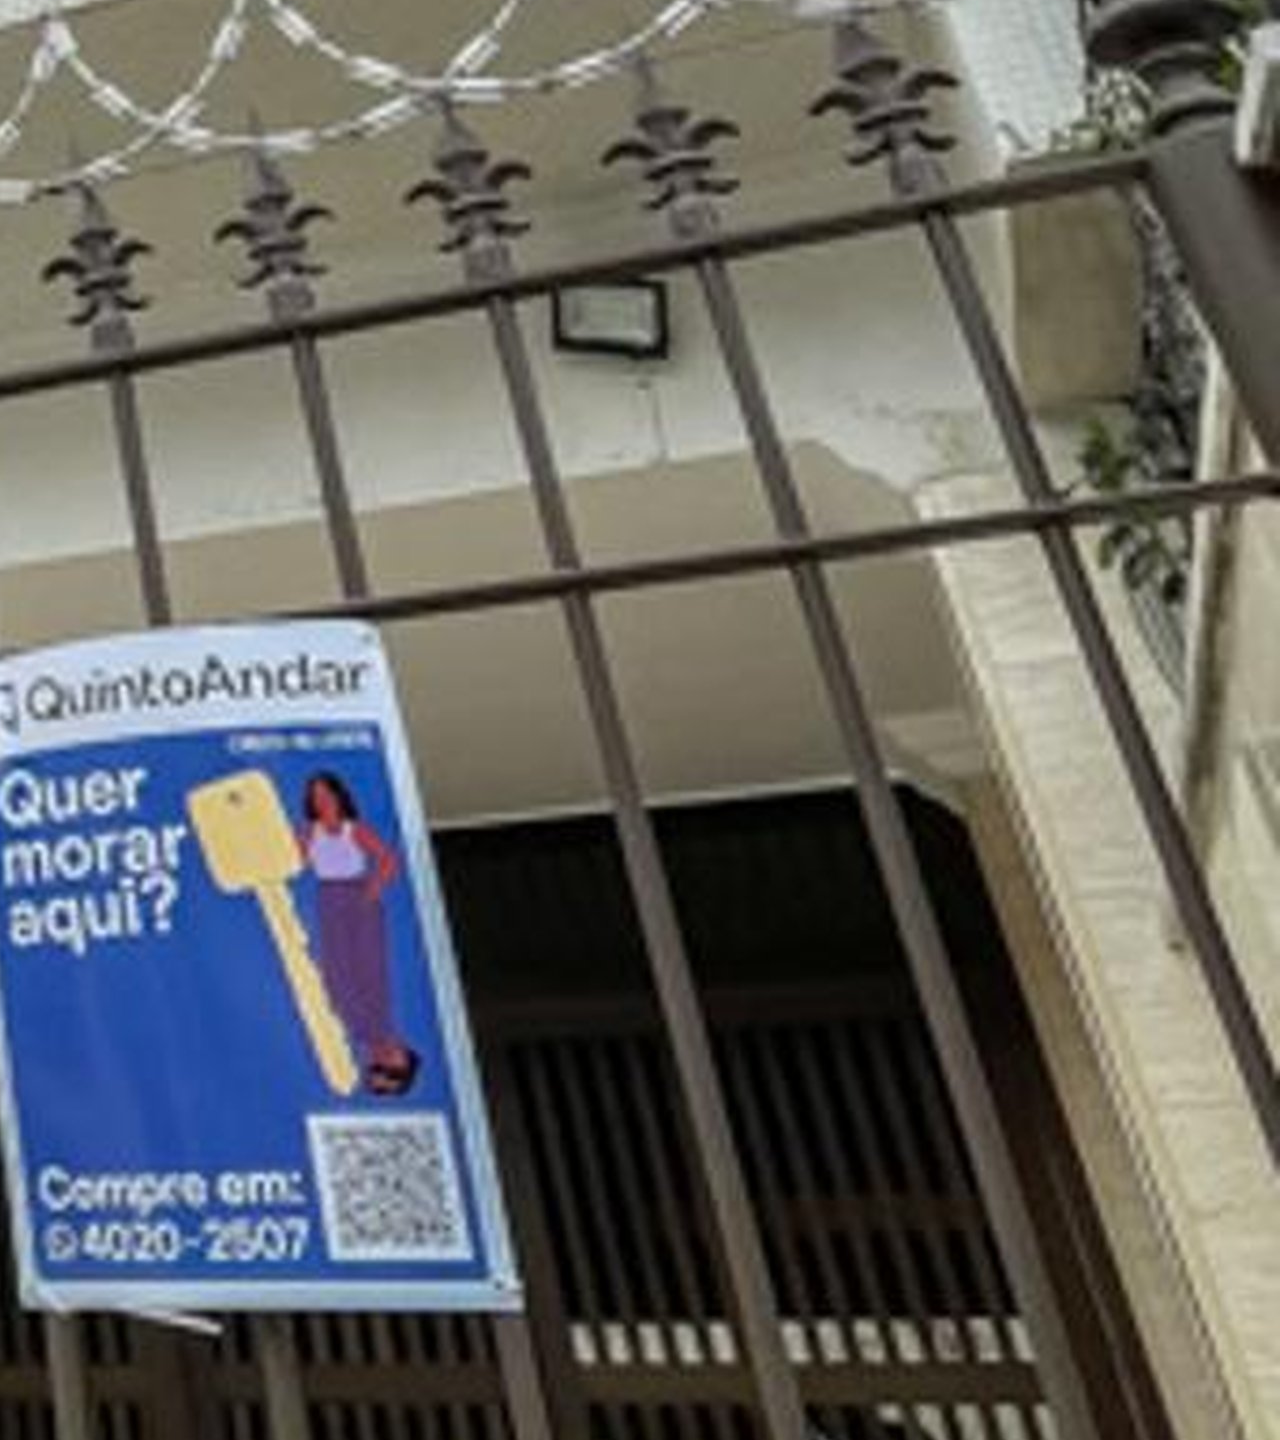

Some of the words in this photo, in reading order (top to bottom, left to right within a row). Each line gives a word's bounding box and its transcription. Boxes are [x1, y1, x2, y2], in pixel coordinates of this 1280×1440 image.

[25, 653, 370, 722] QuintoAndar
[2, 824, 187, 888] morar
[8, 871, 178, 957] aqui?
[38, 1165, 208, 1218] Compre
[217, 1170, 307, 1205] em:
